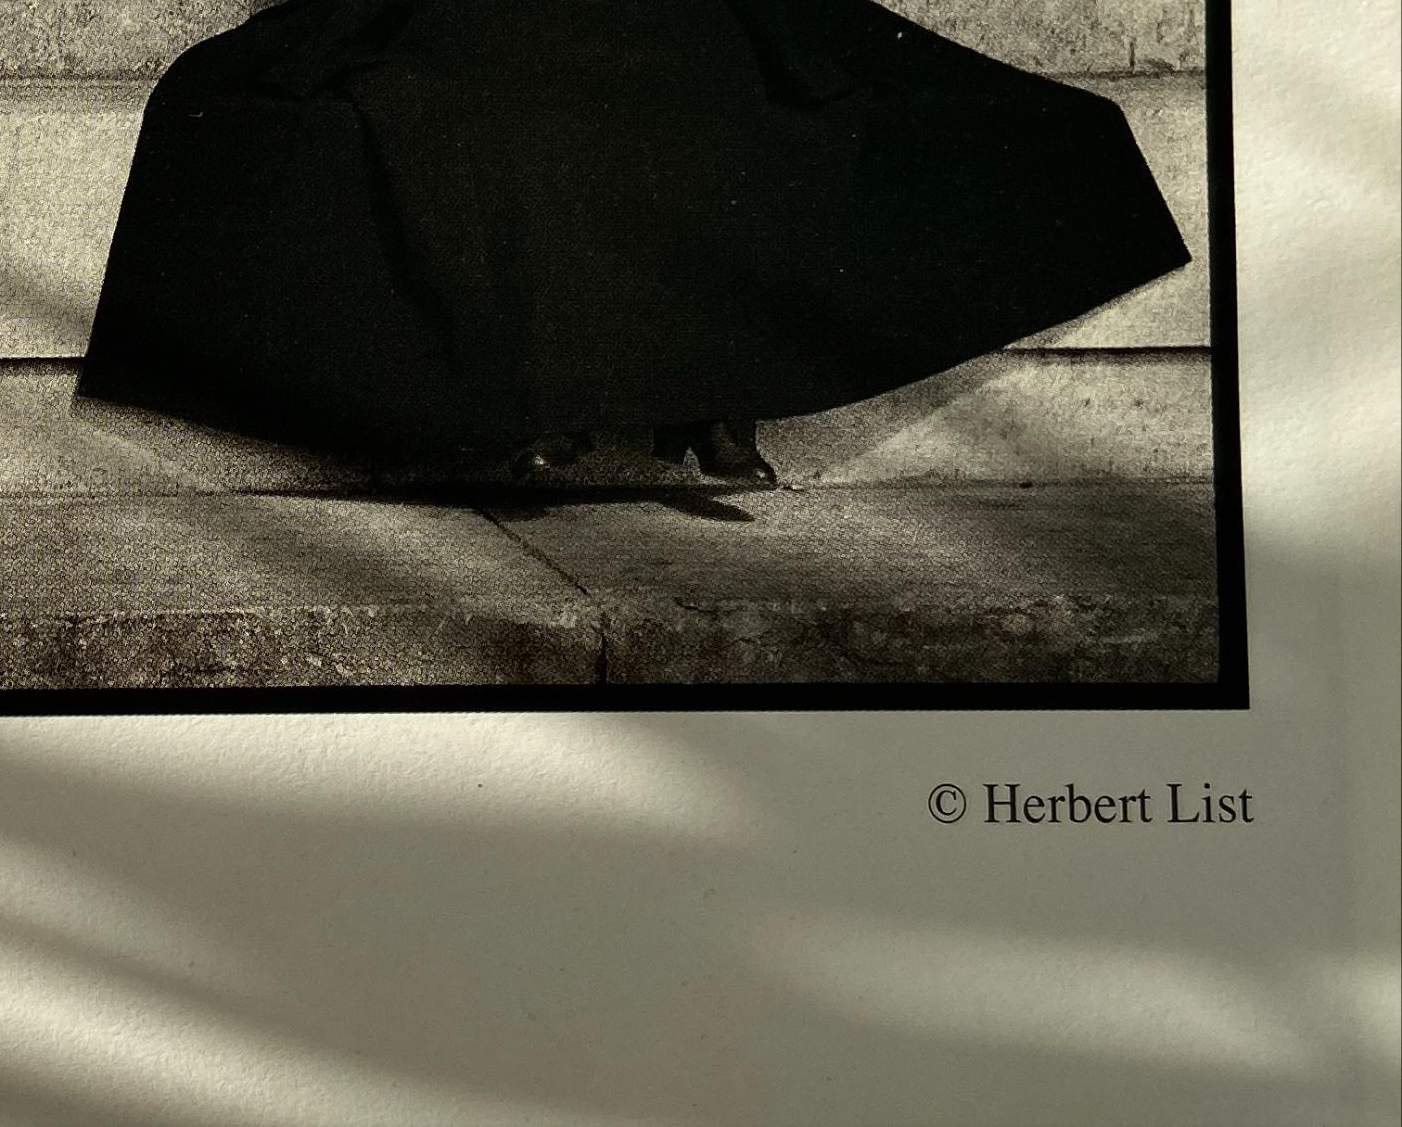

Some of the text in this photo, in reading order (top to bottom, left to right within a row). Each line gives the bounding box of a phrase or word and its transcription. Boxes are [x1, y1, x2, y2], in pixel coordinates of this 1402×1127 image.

[928, 782, 1254, 824] © Herbert List
